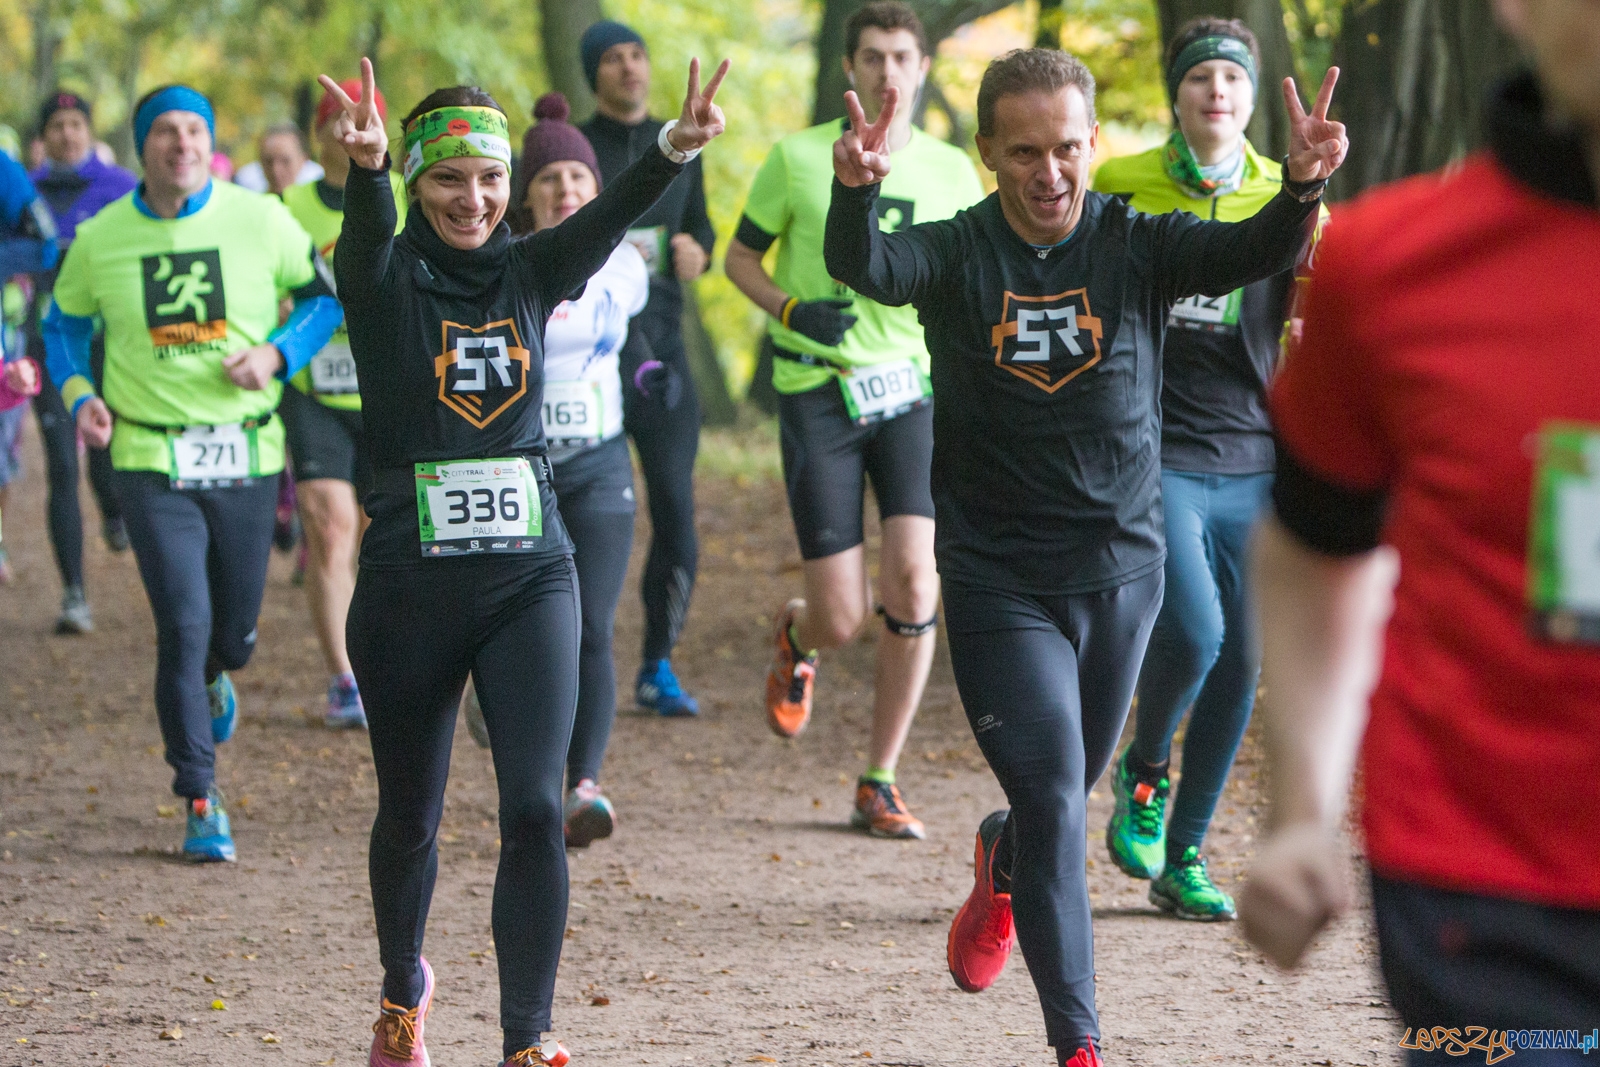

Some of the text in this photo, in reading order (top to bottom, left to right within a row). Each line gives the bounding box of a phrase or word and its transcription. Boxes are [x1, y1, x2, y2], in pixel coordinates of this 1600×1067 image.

[1011, 305, 1084, 361] SR
[321, 358, 356, 377] 30
[452, 336, 513, 390] SR
[856, 367, 912, 402] 1087
[191, 443, 236, 466] 271
[445, 487, 520, 525] 336
[472, 526, 502, 535] PAULA
